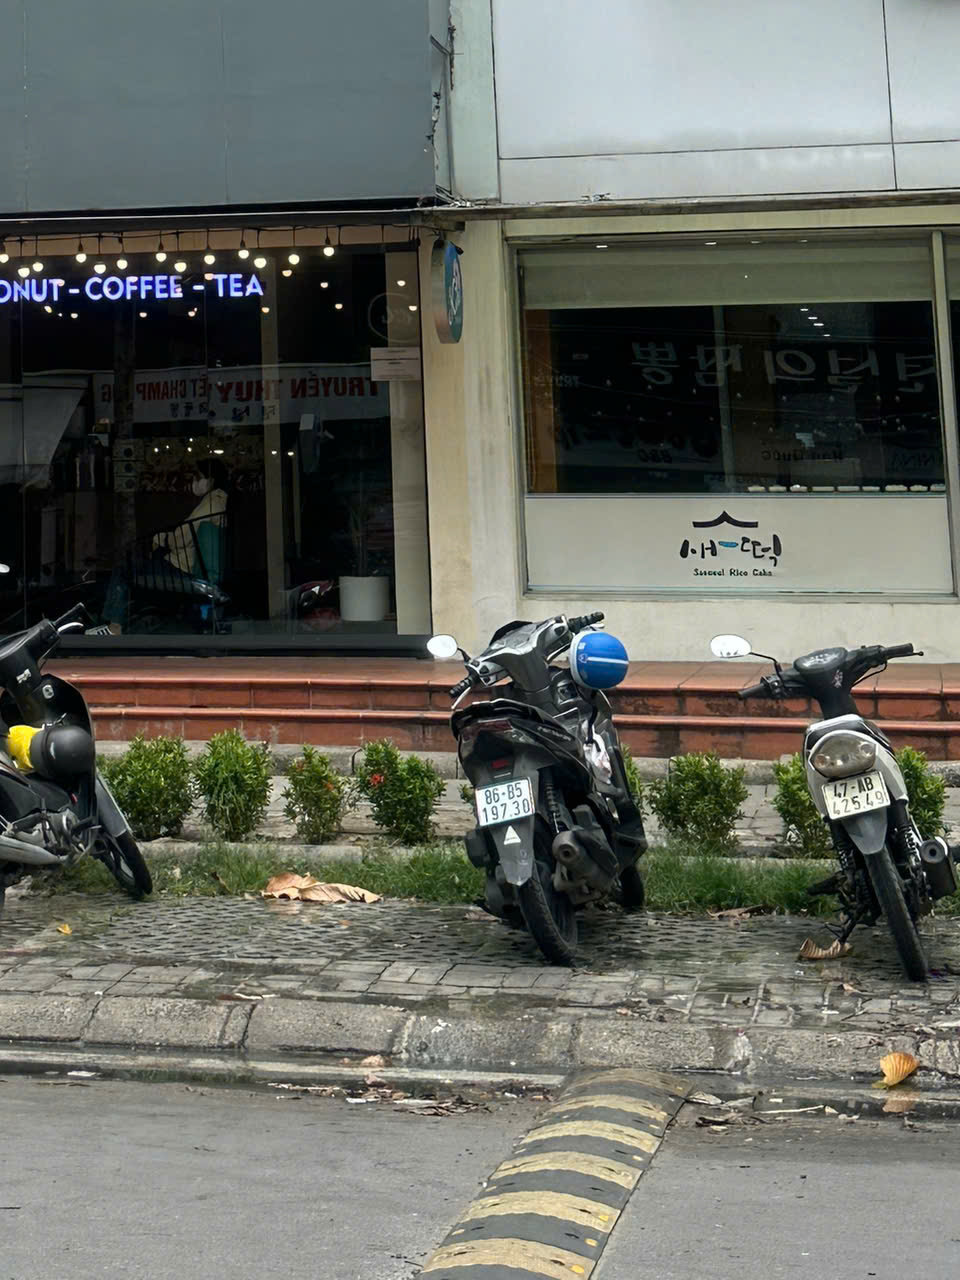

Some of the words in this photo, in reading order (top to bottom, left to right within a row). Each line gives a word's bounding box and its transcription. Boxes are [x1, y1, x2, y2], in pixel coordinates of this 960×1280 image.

[85, 275, 183, 301] COFFEE
[212, 273, 264, 298] TEA
[484, 782, 523, 805] 86-B5
[482, 798, 531, 823] 197.30
